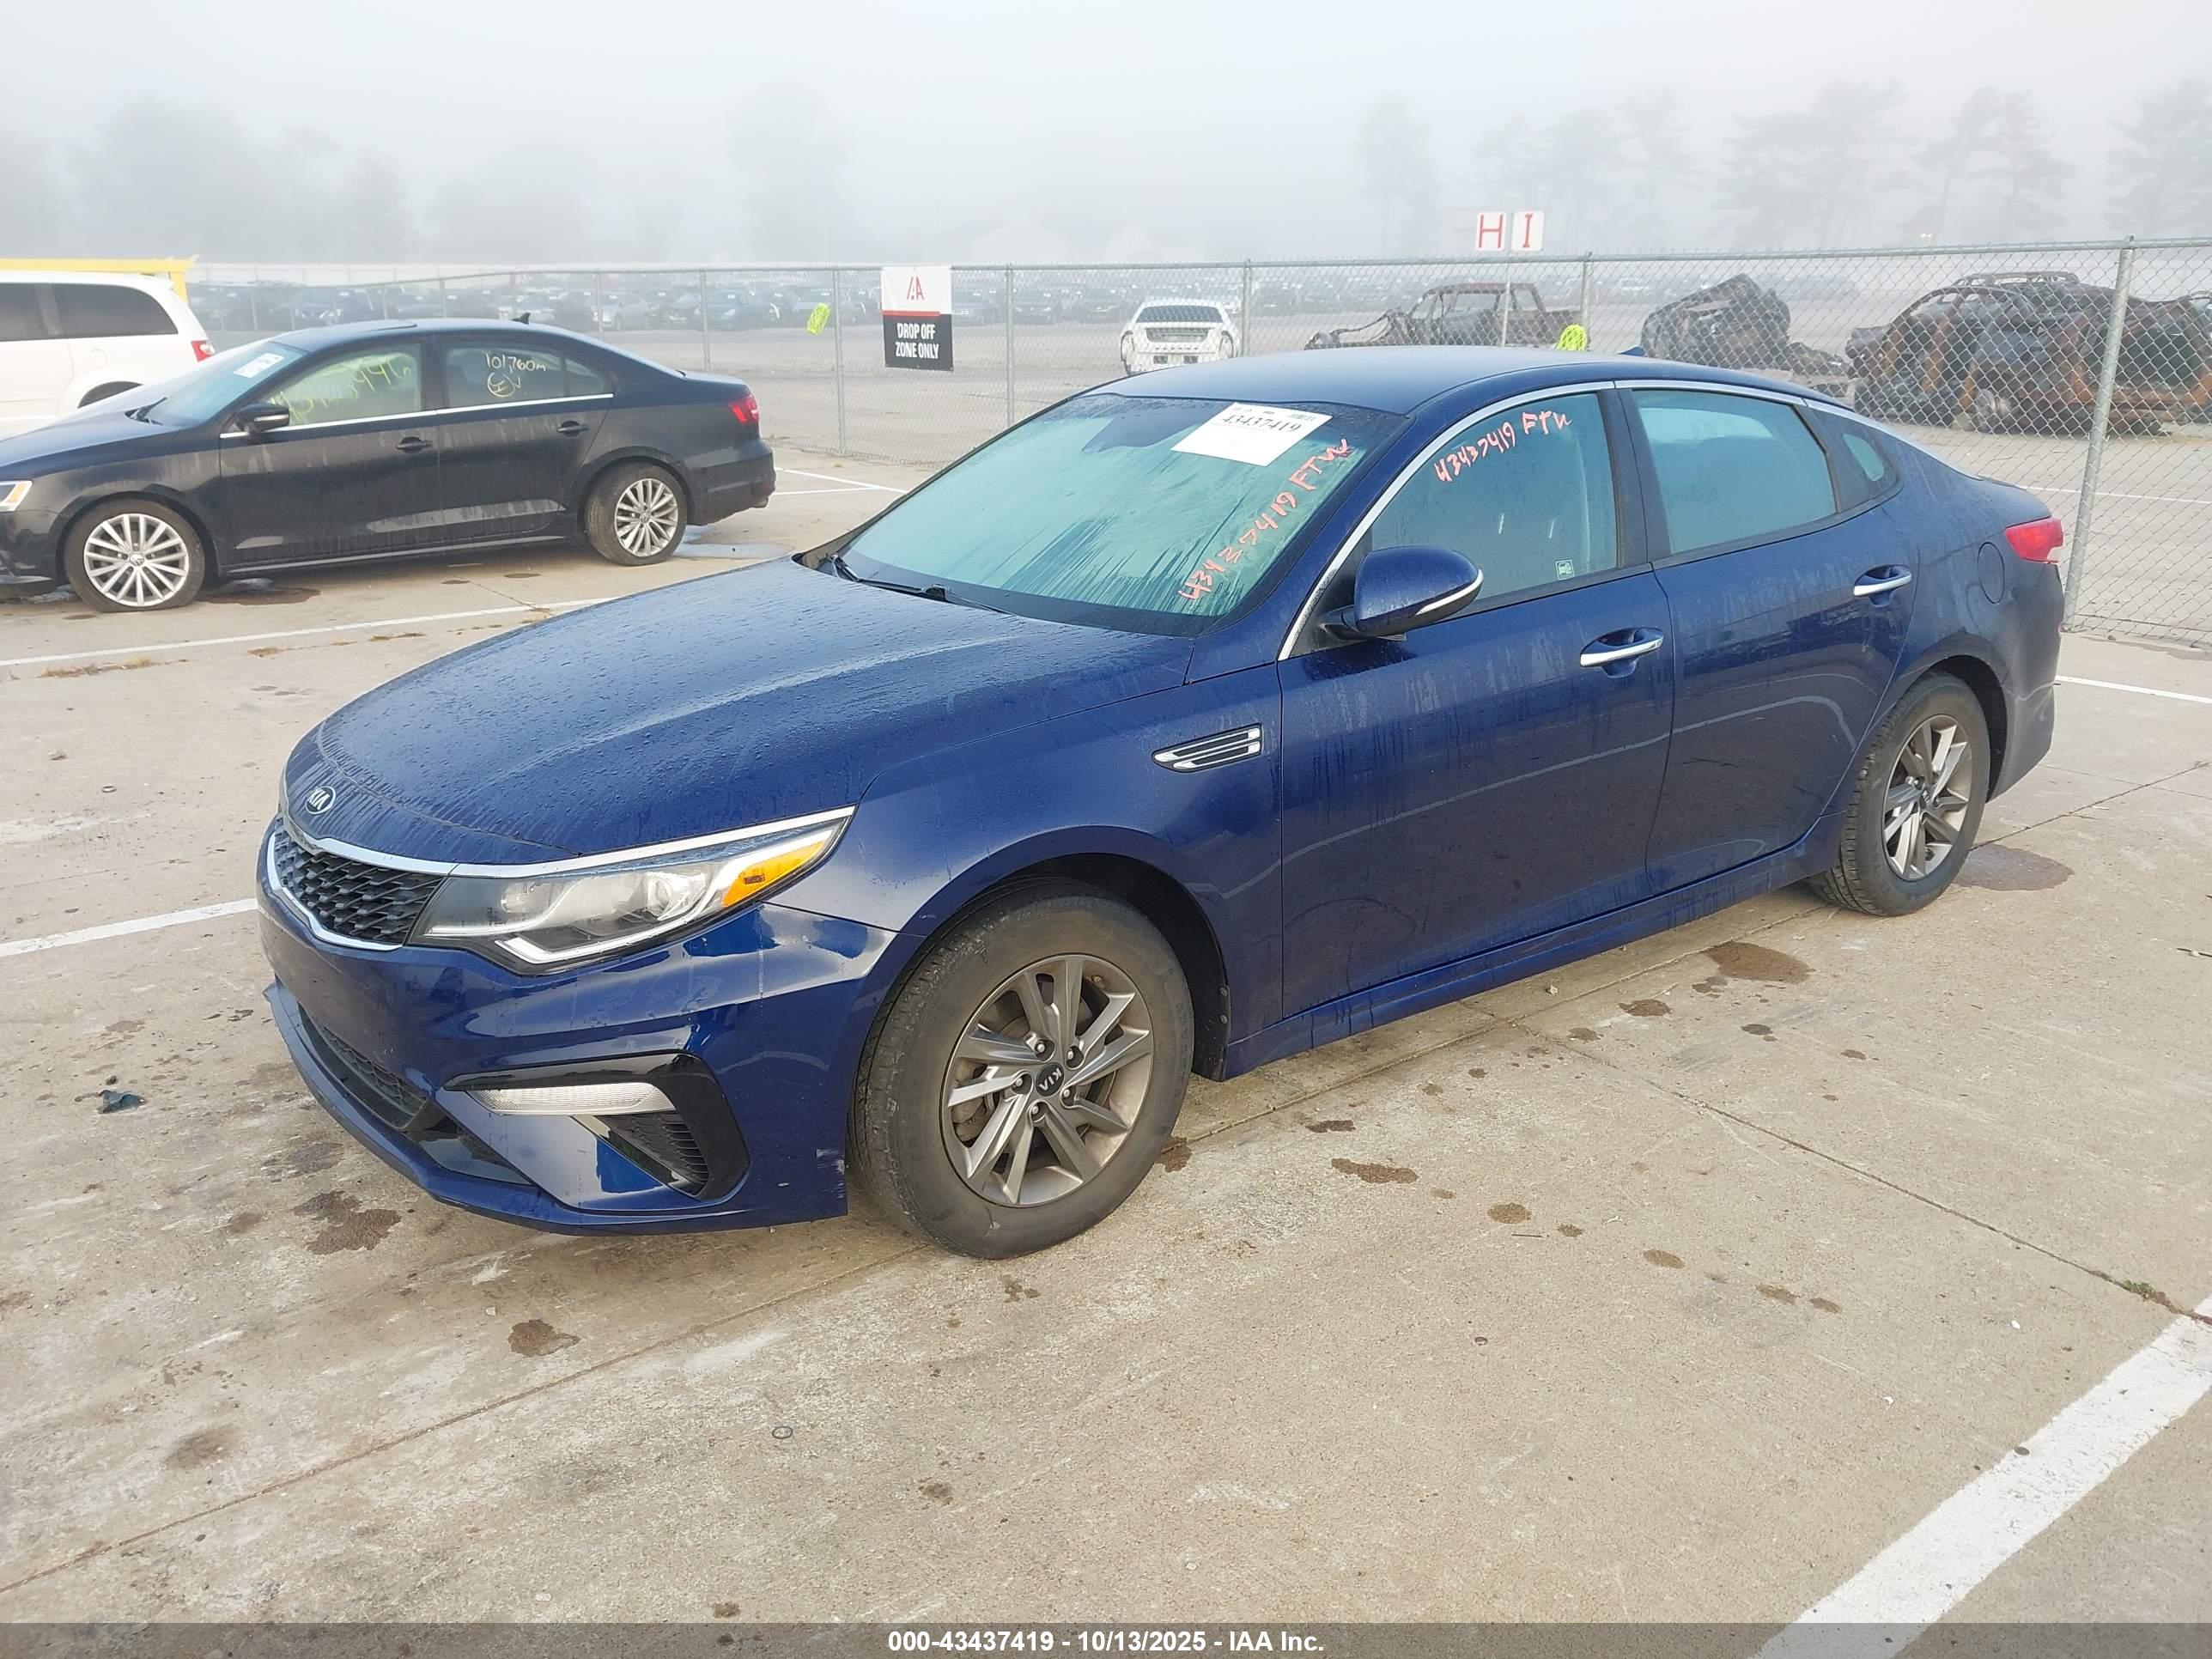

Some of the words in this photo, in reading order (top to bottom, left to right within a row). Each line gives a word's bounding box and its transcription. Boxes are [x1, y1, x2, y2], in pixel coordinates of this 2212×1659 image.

[1479, 214, 1504, 249] H
[1522, 213, 1534, 248] I
[896, 323, 920, 339] DROP
[921, 324, 936, 339] OFF
[895, 342, 918, 357] ZONE
[918, 343, 939, 359] ONLY
[1222, 414, 1302, 433] 43437419
[1434, 422, 1516, 482] 43437419
[1178, 491, 1297, 599] 43437419
